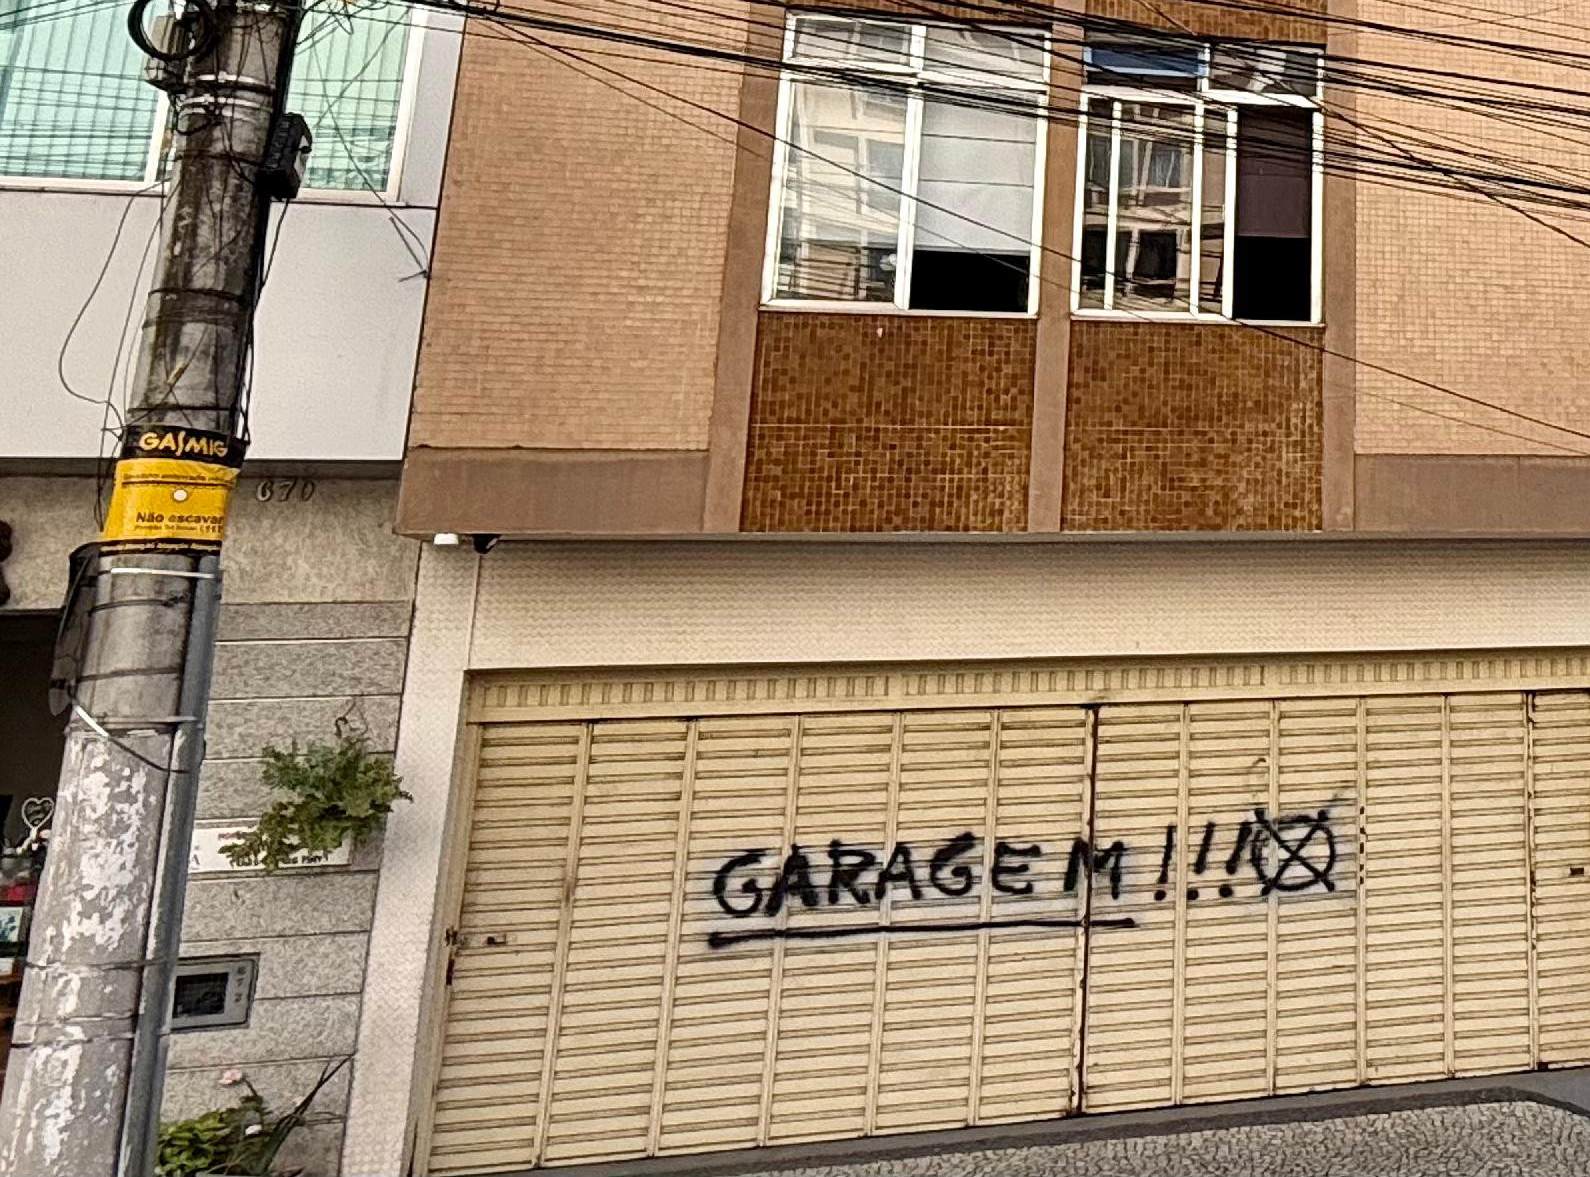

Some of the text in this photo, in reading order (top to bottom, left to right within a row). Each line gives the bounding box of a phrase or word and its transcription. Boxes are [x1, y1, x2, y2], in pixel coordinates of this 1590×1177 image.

[138, 430, 228, 457] GASMIG
[256, 478, 315, 502] 670
[136, 512, 165, 523] Não
